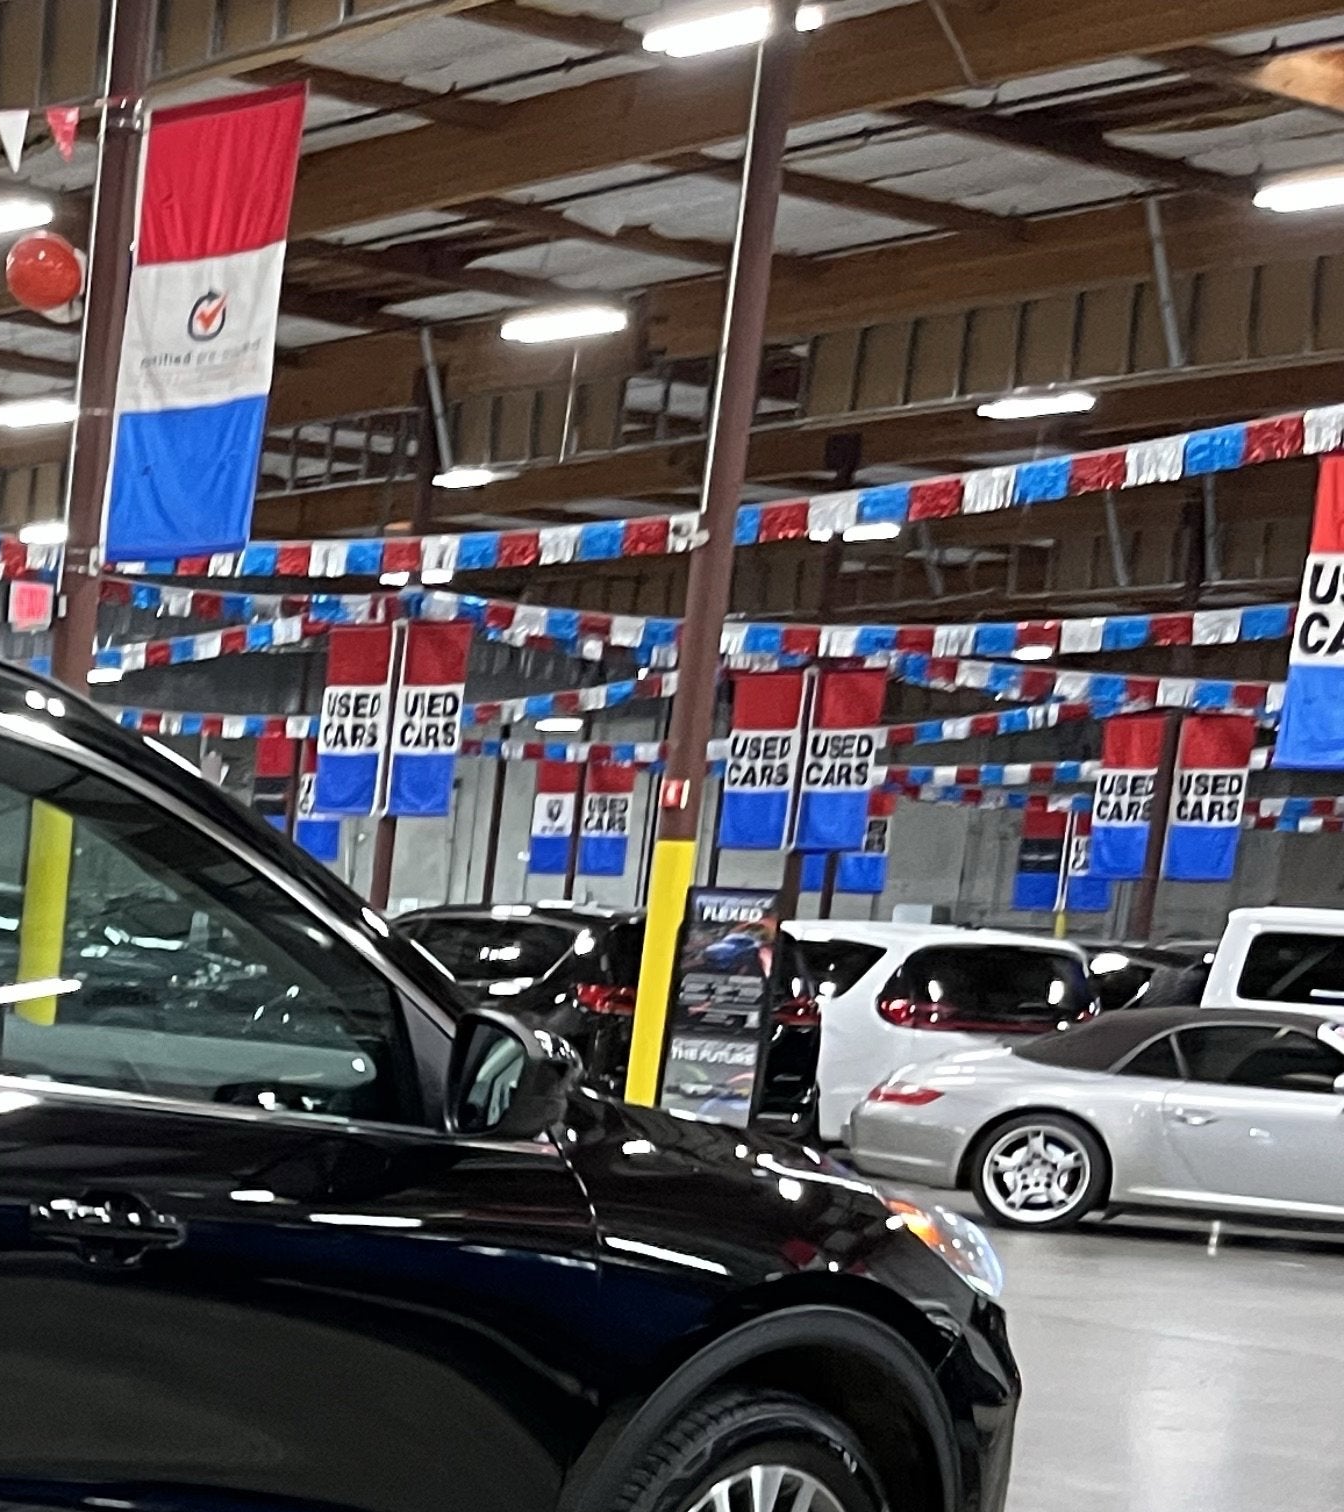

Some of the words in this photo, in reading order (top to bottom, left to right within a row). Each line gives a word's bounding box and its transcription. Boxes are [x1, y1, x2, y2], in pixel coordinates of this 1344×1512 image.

[327, 692, 381, 718] USED
[323, 722, 379, 748] CARS
[811, 734, 873, 759] USED
[731, 735, 791, 761] USED
[727, 762, 789, 787] CARS
[805, 761, 869, 787] CARS
[1179, 773, 1243, 797] USED
[1176, 799, 1240, 822] CARS
